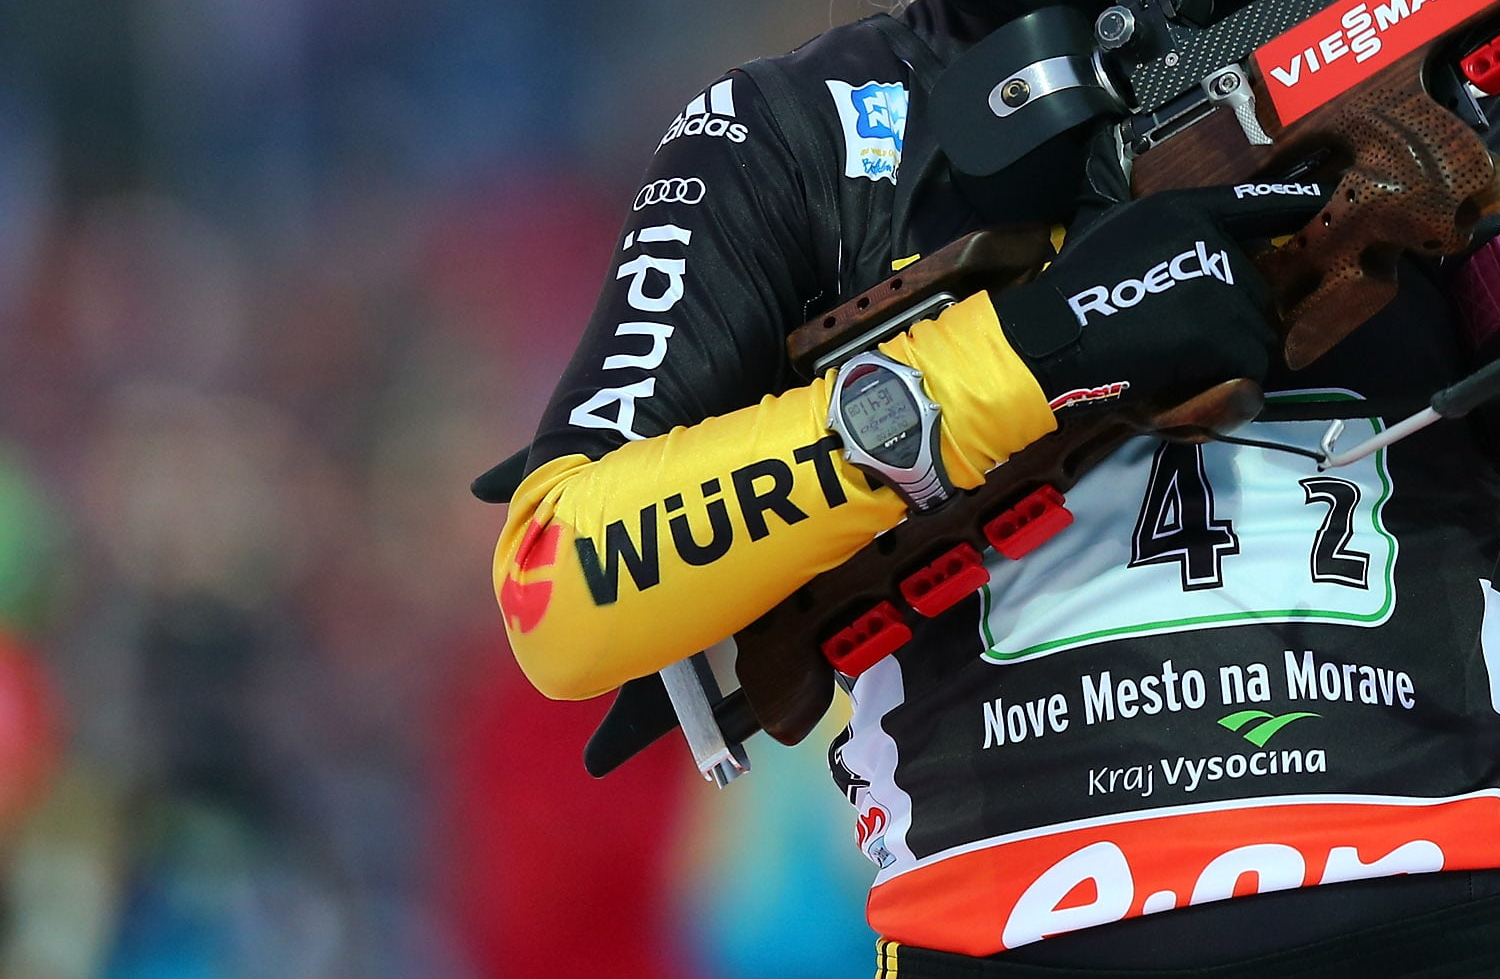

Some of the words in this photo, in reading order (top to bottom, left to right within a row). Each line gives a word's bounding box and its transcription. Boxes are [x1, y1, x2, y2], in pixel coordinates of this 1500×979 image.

[654, 112, 749, 154] didas
[568, 224, 693, 442] Audi
[574, 435, 885, 607] WÜRT
[1127, 439, 1241, 593] 4
[1298, 475, 1371, 590] 2
[982, 692, 1069, 750] Nove
[1081, 659, 1206, 726] Mesto
[1219, 661, 1272, 705] na
[1284, 650, 1417, 710] Morave
[1087, 763, 1155, 797] Kraj
[1160, 748, 1327, 792] Vysocina
